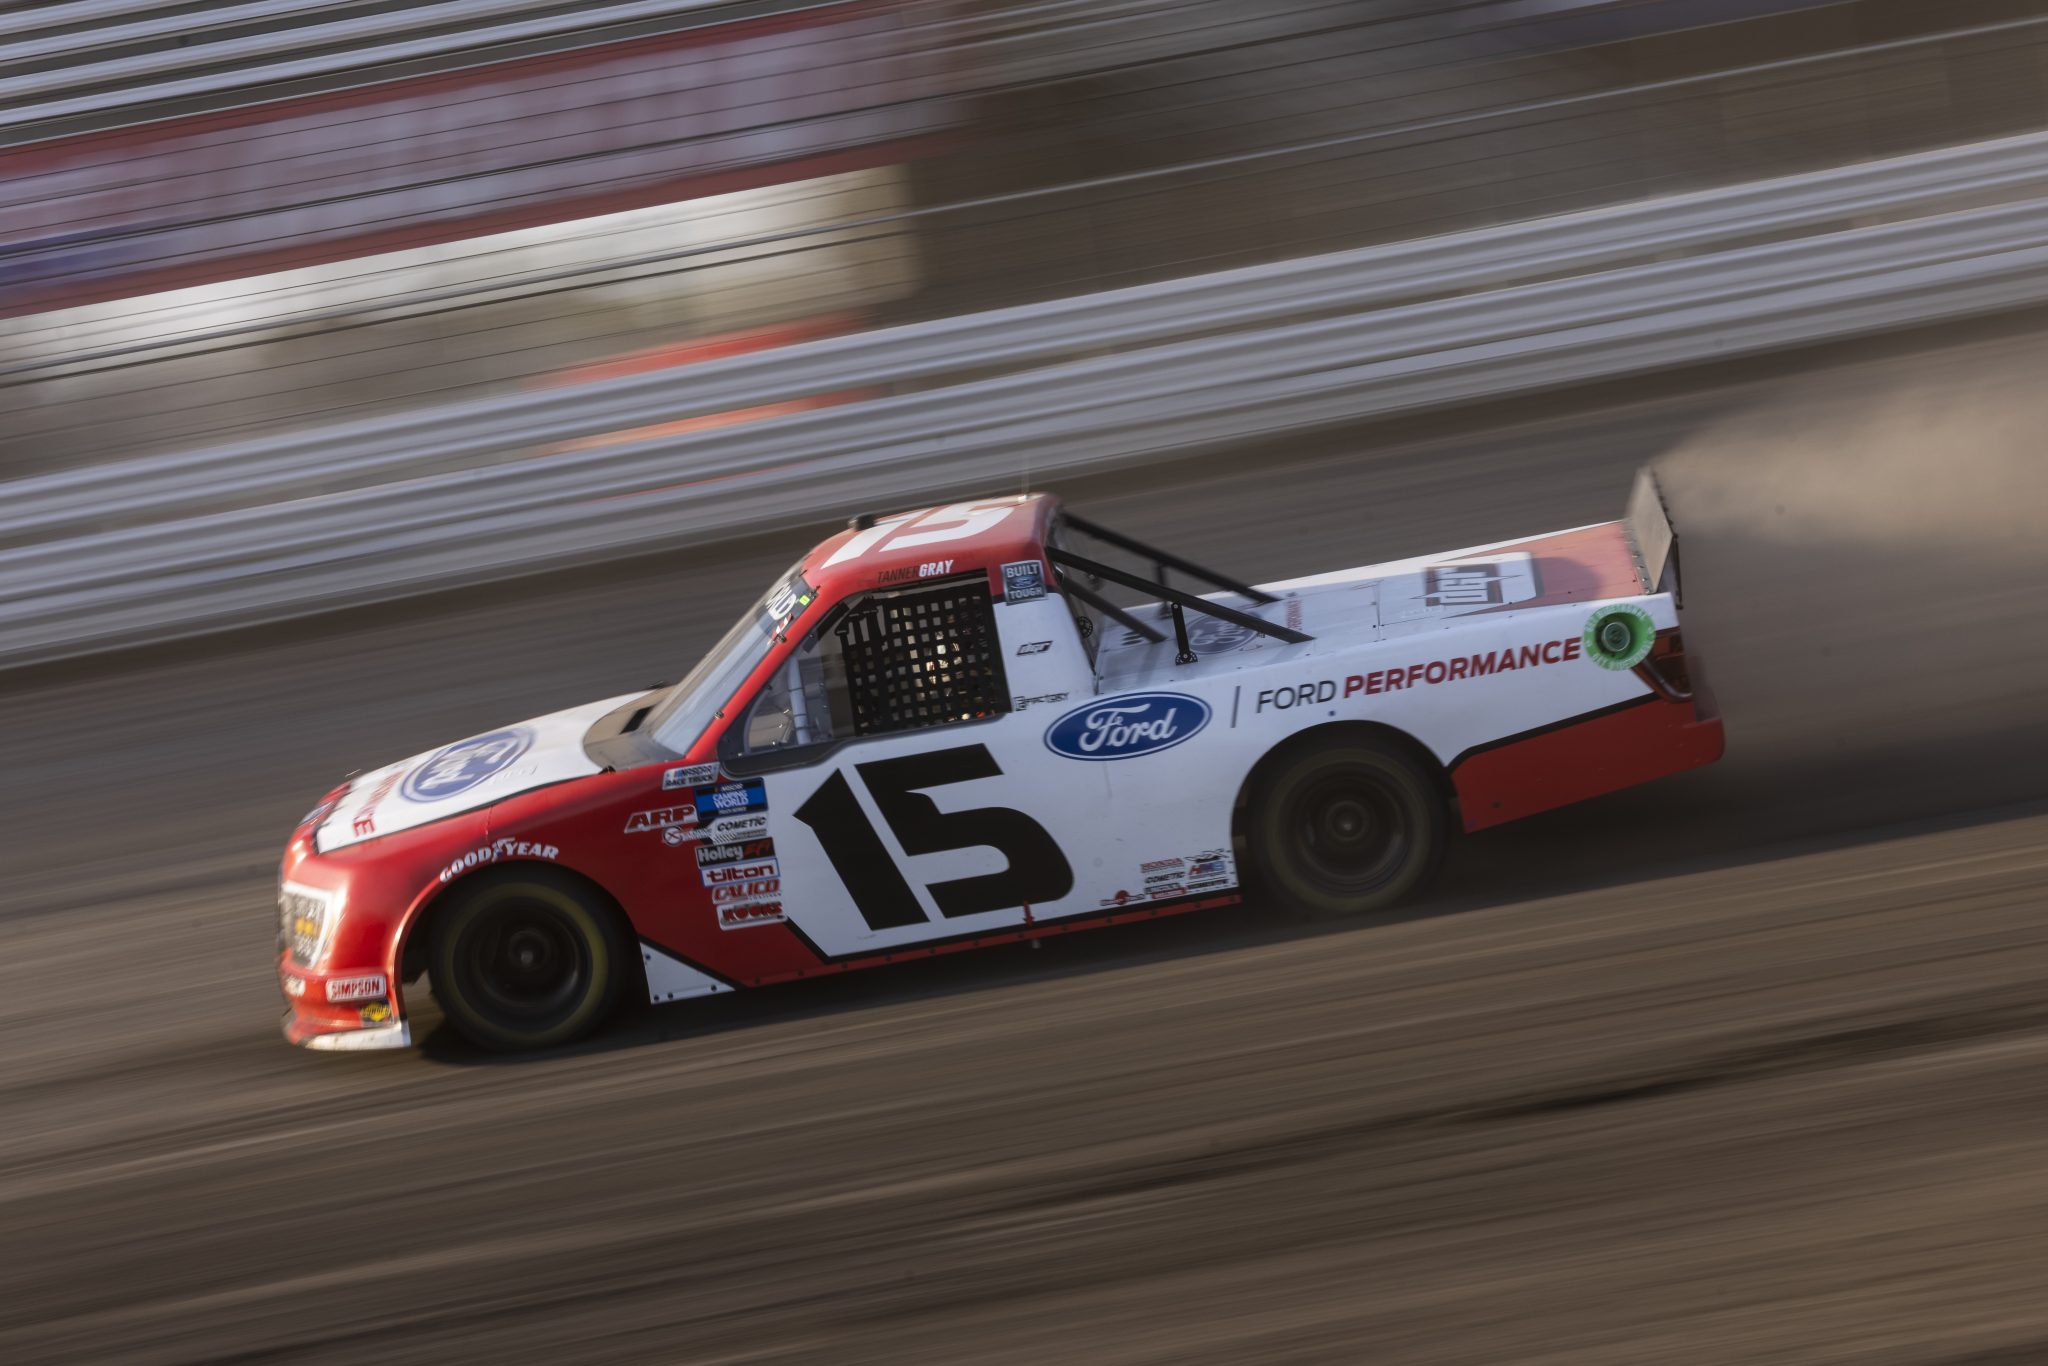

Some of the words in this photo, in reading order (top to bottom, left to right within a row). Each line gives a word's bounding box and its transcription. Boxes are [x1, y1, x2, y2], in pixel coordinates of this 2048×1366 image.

[918, 559, 954, 577] GRAY
[1007, 563, 1040, 578] BUILT
[1009, 587, 1043, 600] TOUGH
[1255, 680, 1337, 713] FORD
[1342, 636, 1582, 699] PERFORMANCE
[1079, 703, 1178, 751] Ford
[665, 777, 686, 787] RACE
[688, 774, 714, 784] TRUCK
[714, 797, 749, 809] WORLD
[628, 807, 696, 830] ARP
[717, 816, 766, 832] COMETIC
[792, 742, 1075, 931] 15
[440, 837, 559, 882] GOODYEAR
[698, 844, 743, 863] Holley
[706, 864, 775, 883] tilton
[714, 879, 781, 901] CALICO
[331, 979, 380, 998] SIMPSON
